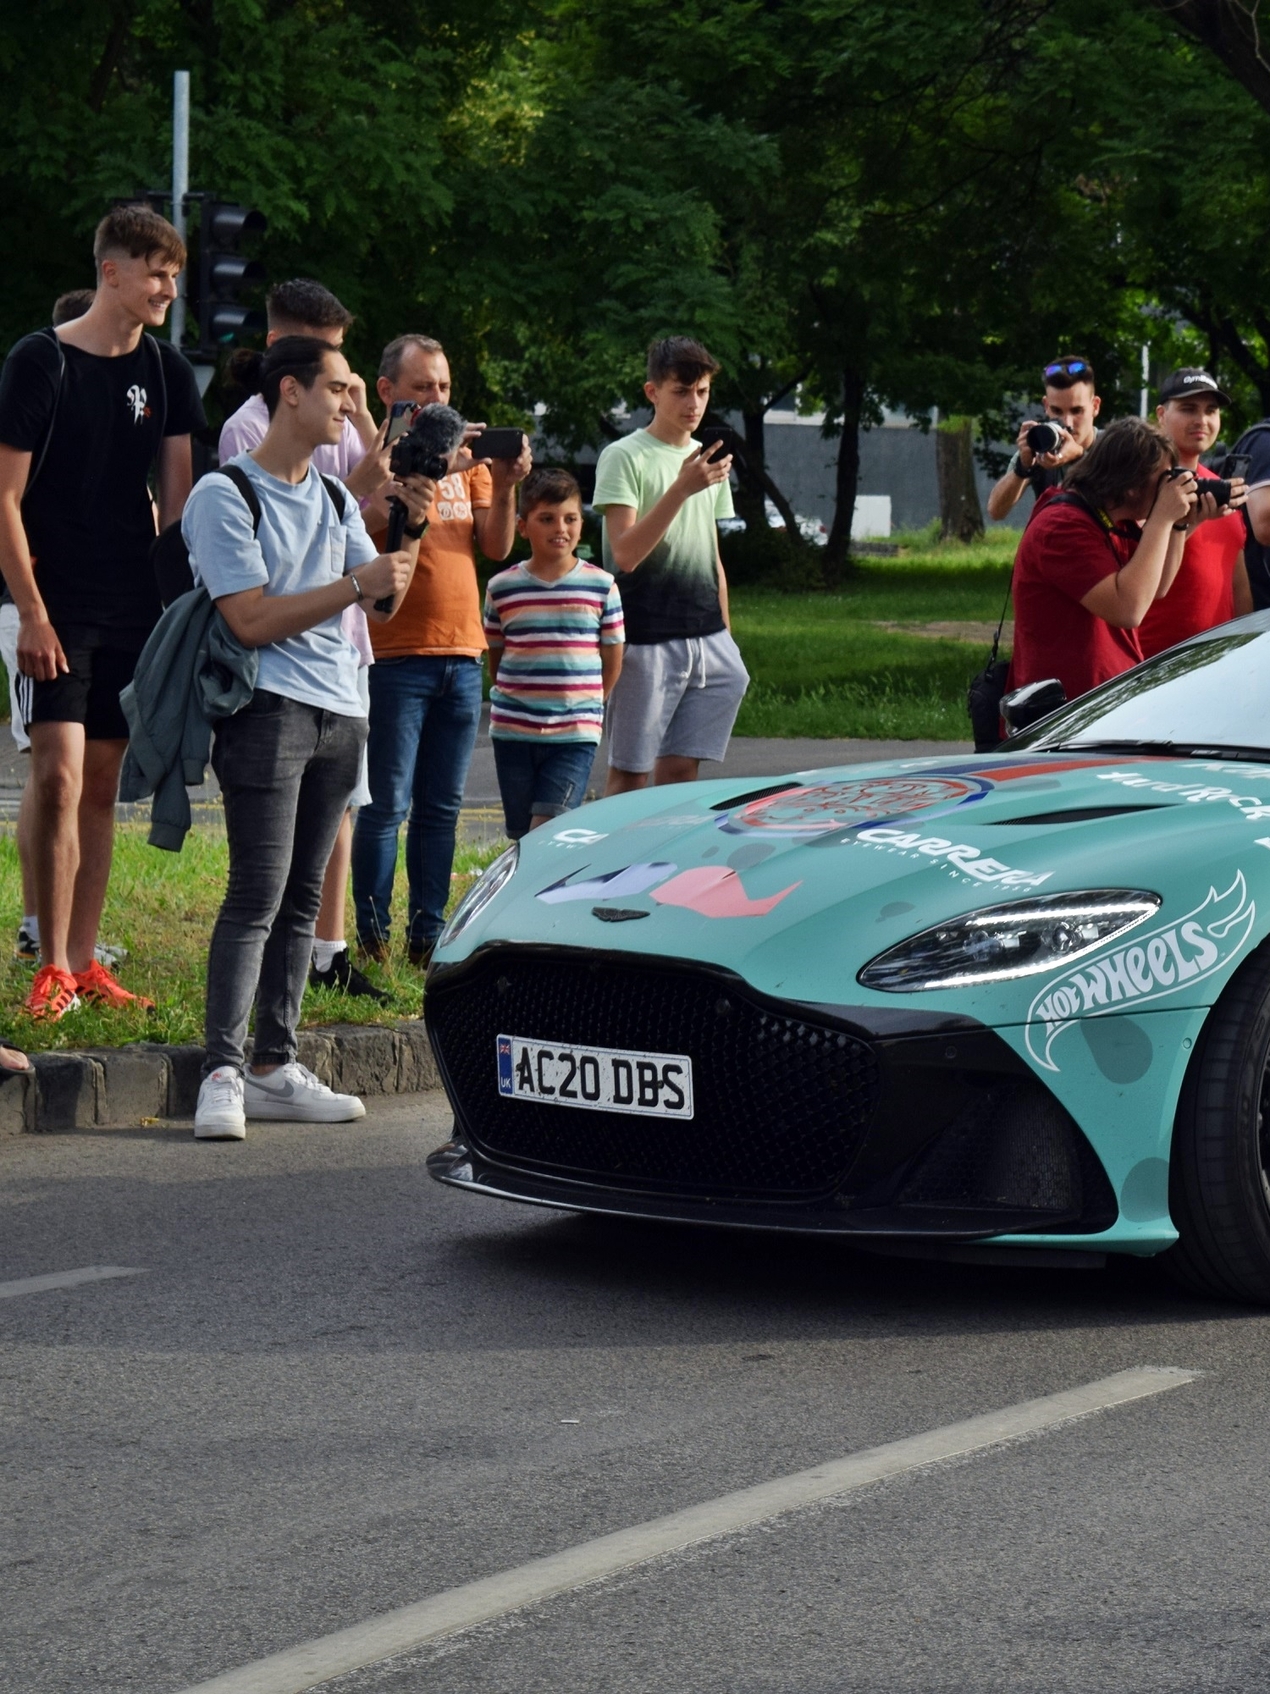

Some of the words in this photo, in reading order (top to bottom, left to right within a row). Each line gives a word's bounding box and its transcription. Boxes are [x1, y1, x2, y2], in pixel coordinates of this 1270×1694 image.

[840, 837, 920, 860] EYEWEAR
[929, 858, 983, 888] SINCE
[992, 884, 1033, 893] 1956
[856, 828, 1056, 887] CARRERA
[500, 1077, 512, 1089] UK
[517, 1046, 601, 1101] AC20
[611, 1057, 685, 1110] DBS
